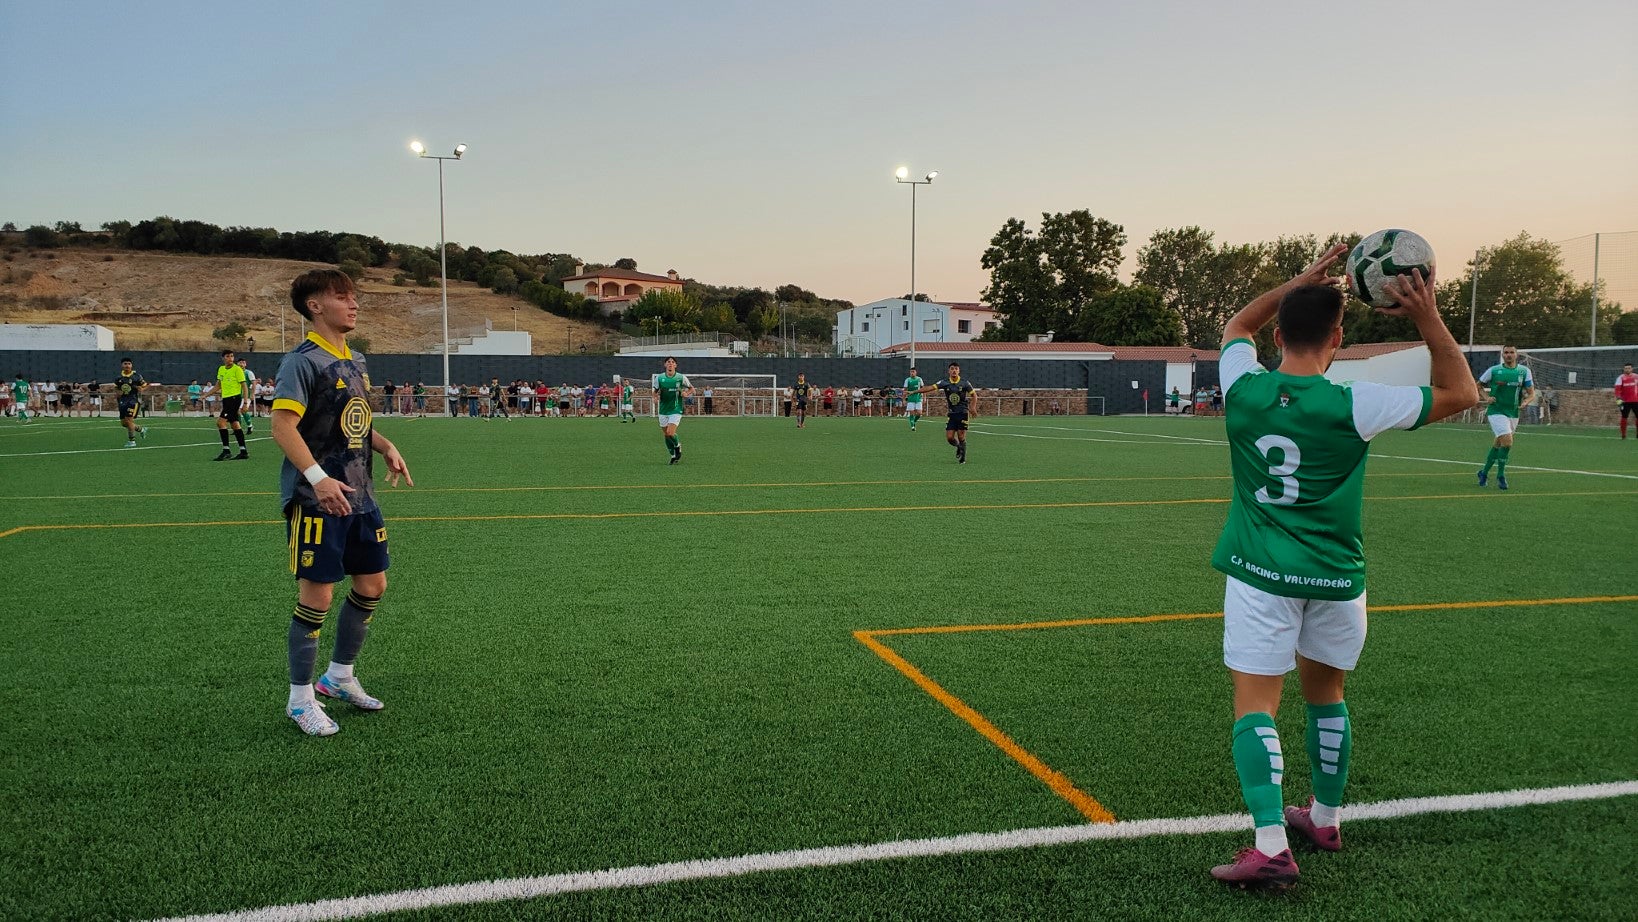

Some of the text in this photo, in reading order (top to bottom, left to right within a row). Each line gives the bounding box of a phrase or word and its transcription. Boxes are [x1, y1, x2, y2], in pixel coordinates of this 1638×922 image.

[1254, 434, 1301, 505] 3
[303, 516, 324, 545] 11
[1230, 555, 1352, 588] C.P. RACING VALVERDEÑO
